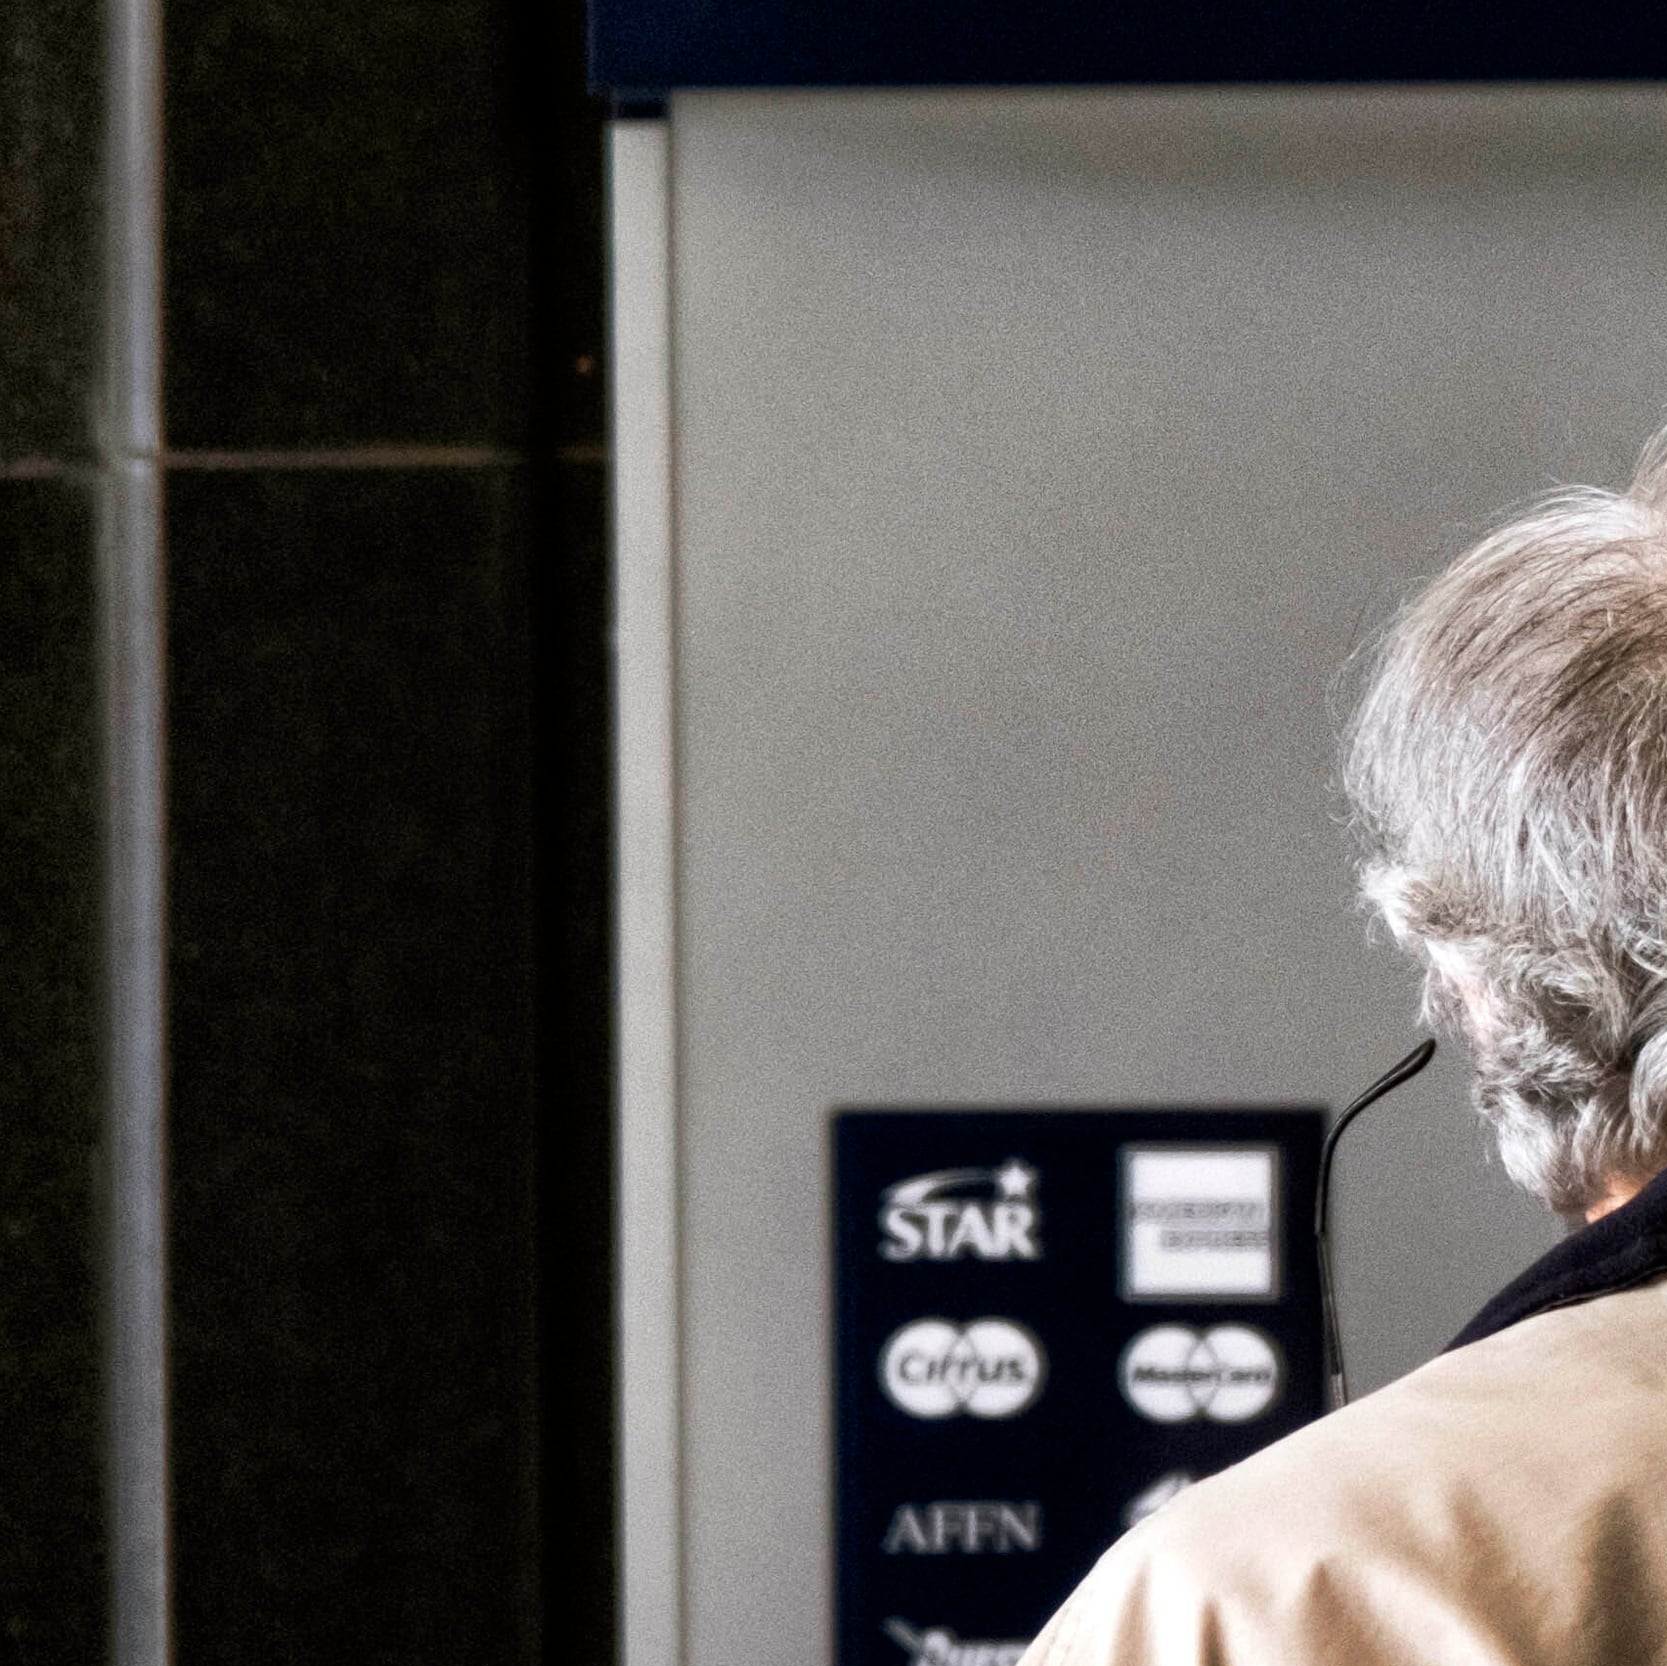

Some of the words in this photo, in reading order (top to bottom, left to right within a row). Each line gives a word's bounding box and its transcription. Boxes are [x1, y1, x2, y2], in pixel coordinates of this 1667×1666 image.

[881, 1200, 1040, 1261] STAR
[898, 1340, 1029, 1386] Cirrus
[883, 1502, 1041, 1555] AFFN
